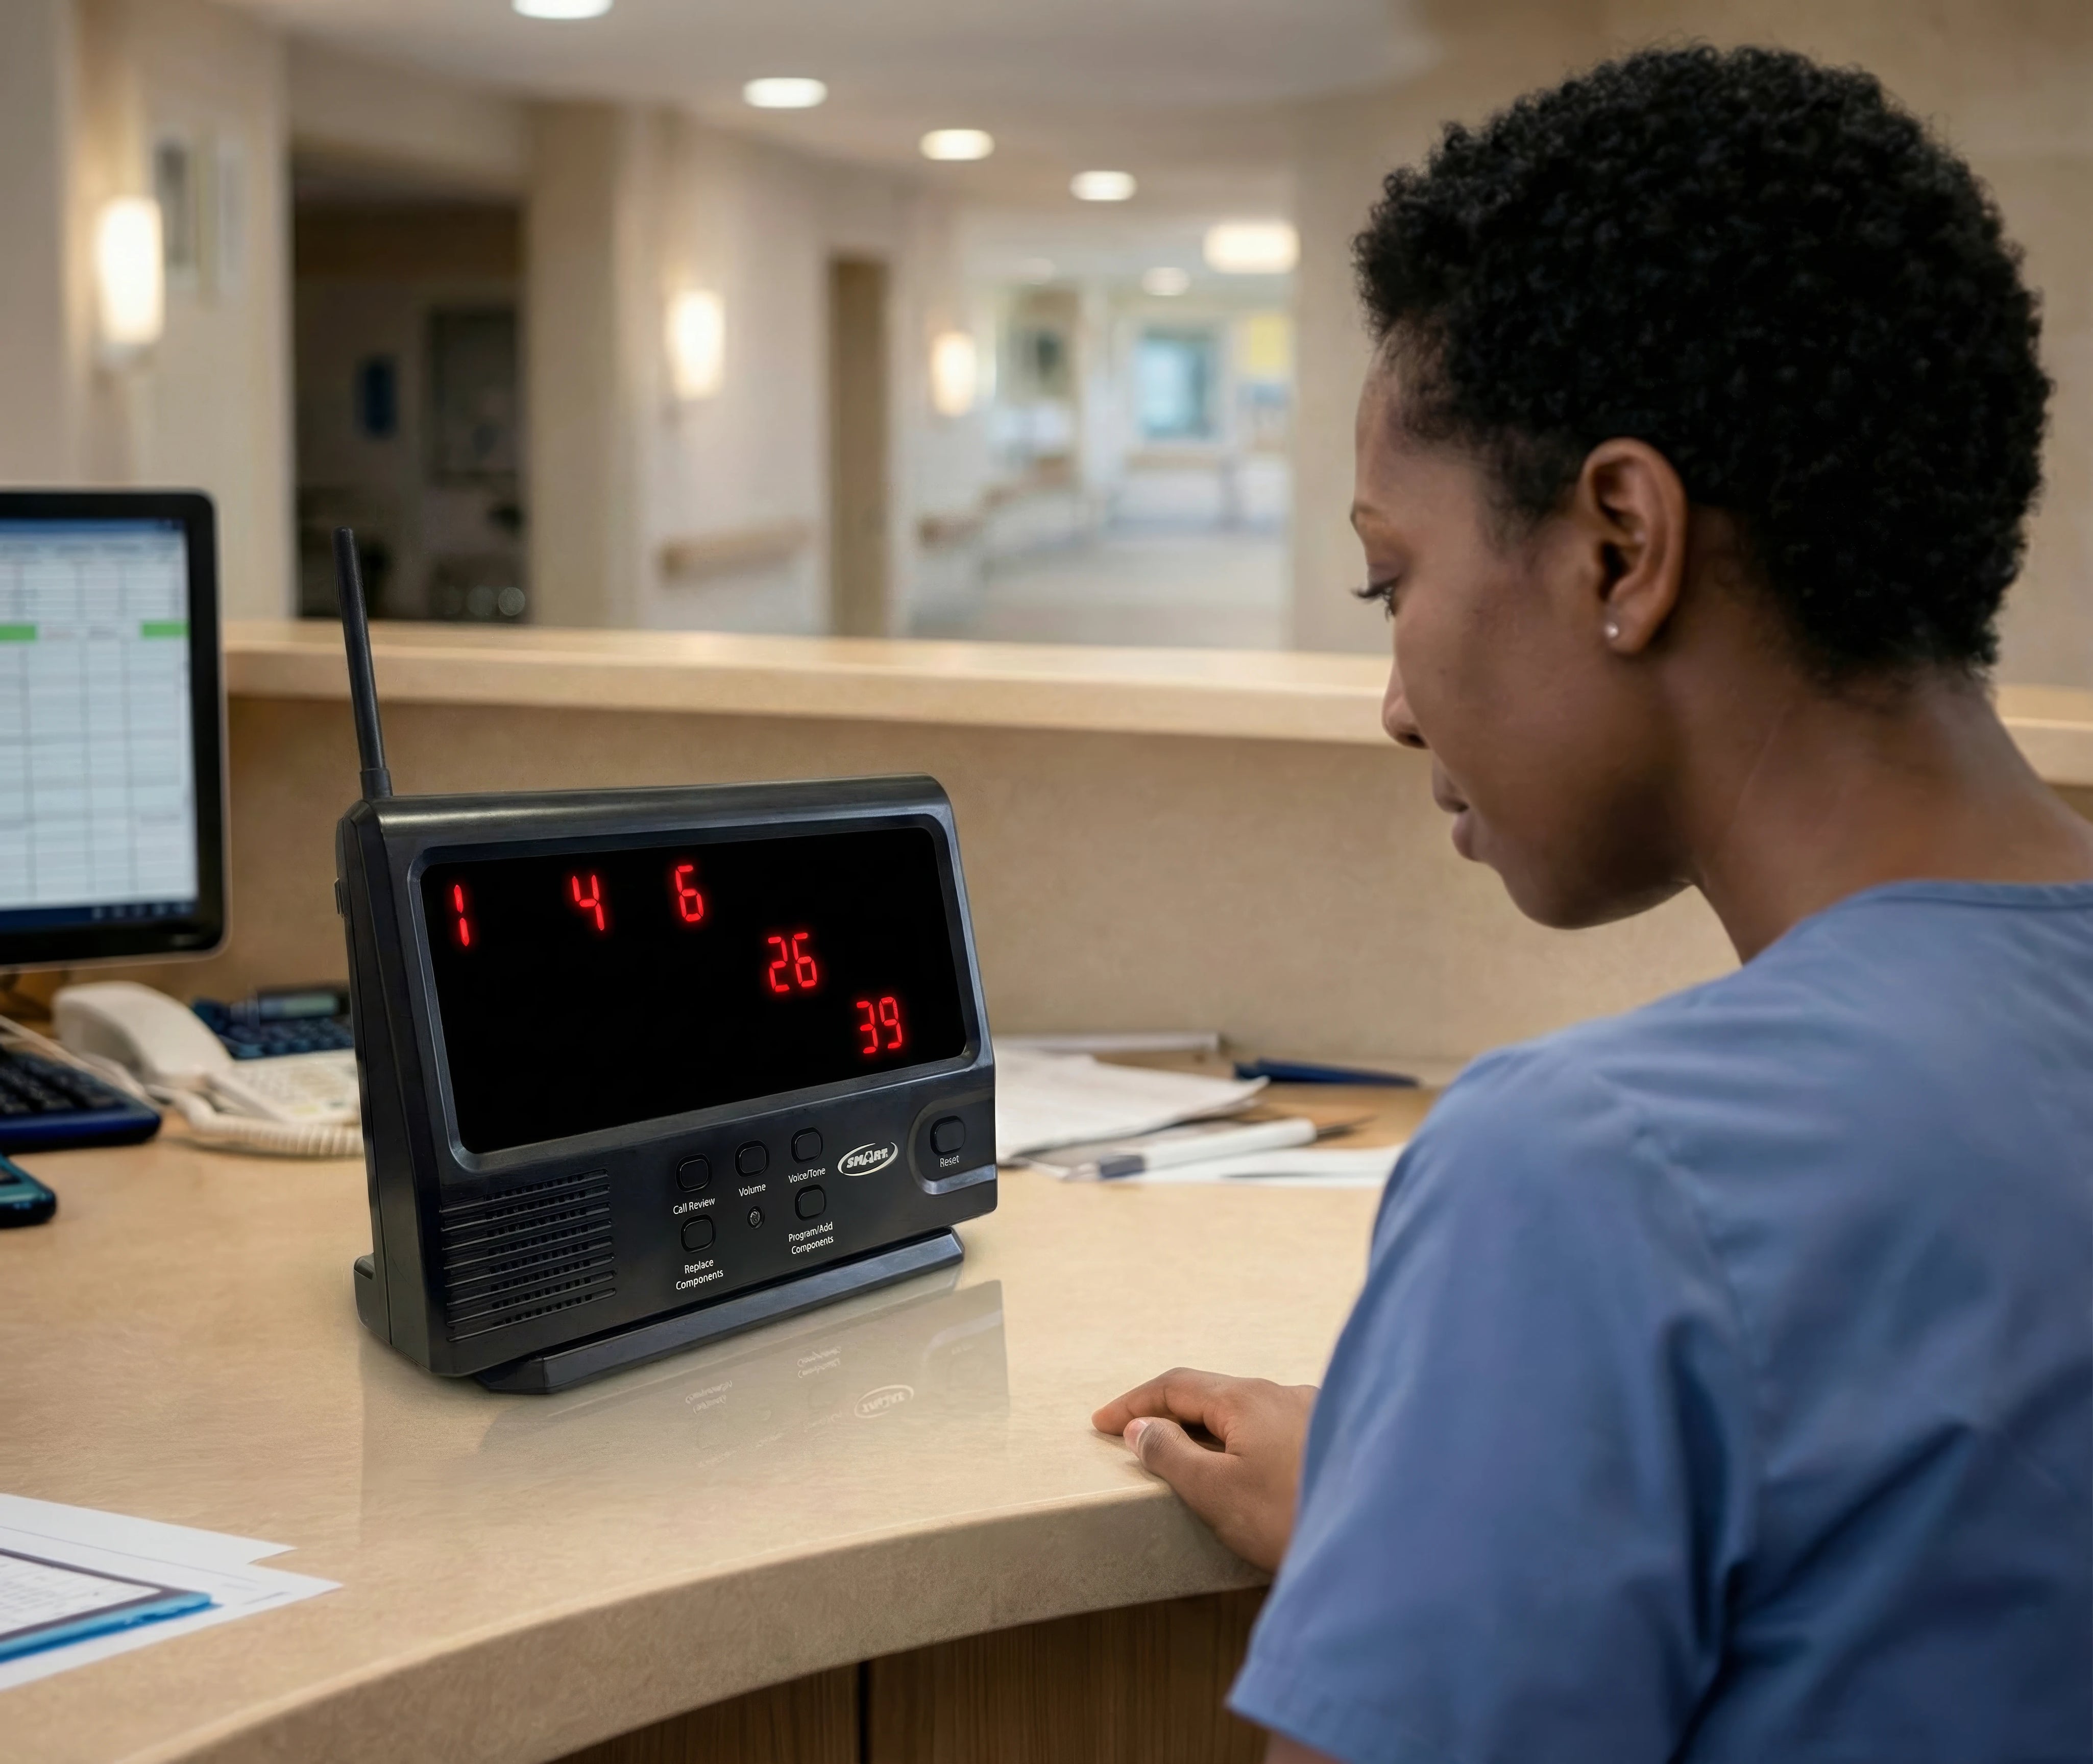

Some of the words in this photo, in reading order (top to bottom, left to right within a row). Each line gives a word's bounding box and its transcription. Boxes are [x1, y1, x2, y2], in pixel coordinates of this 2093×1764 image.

[453, 884, 470, 947] 1
[571, 875, 605, 931] 4
[675, 864, 704, 923] 6
[768, 932, 817, 993] 26
[856, 996, 903, 1054] 39
[940, 1155, 960, 1168] Reset
[788, 1168, 826, 1183] Voice/Tone
[738, 1183, 766, 1197] Volume
[673, 1202, 687, 1215] Call
[689, 1198, 715, 1211] Review
[788, 1221, 833, 1242] Program/Add
[791, 1236, 834, 1254] Components
[684, 1259, 714, 1274] Replace
[676, 1270, 724, 1290] Components
